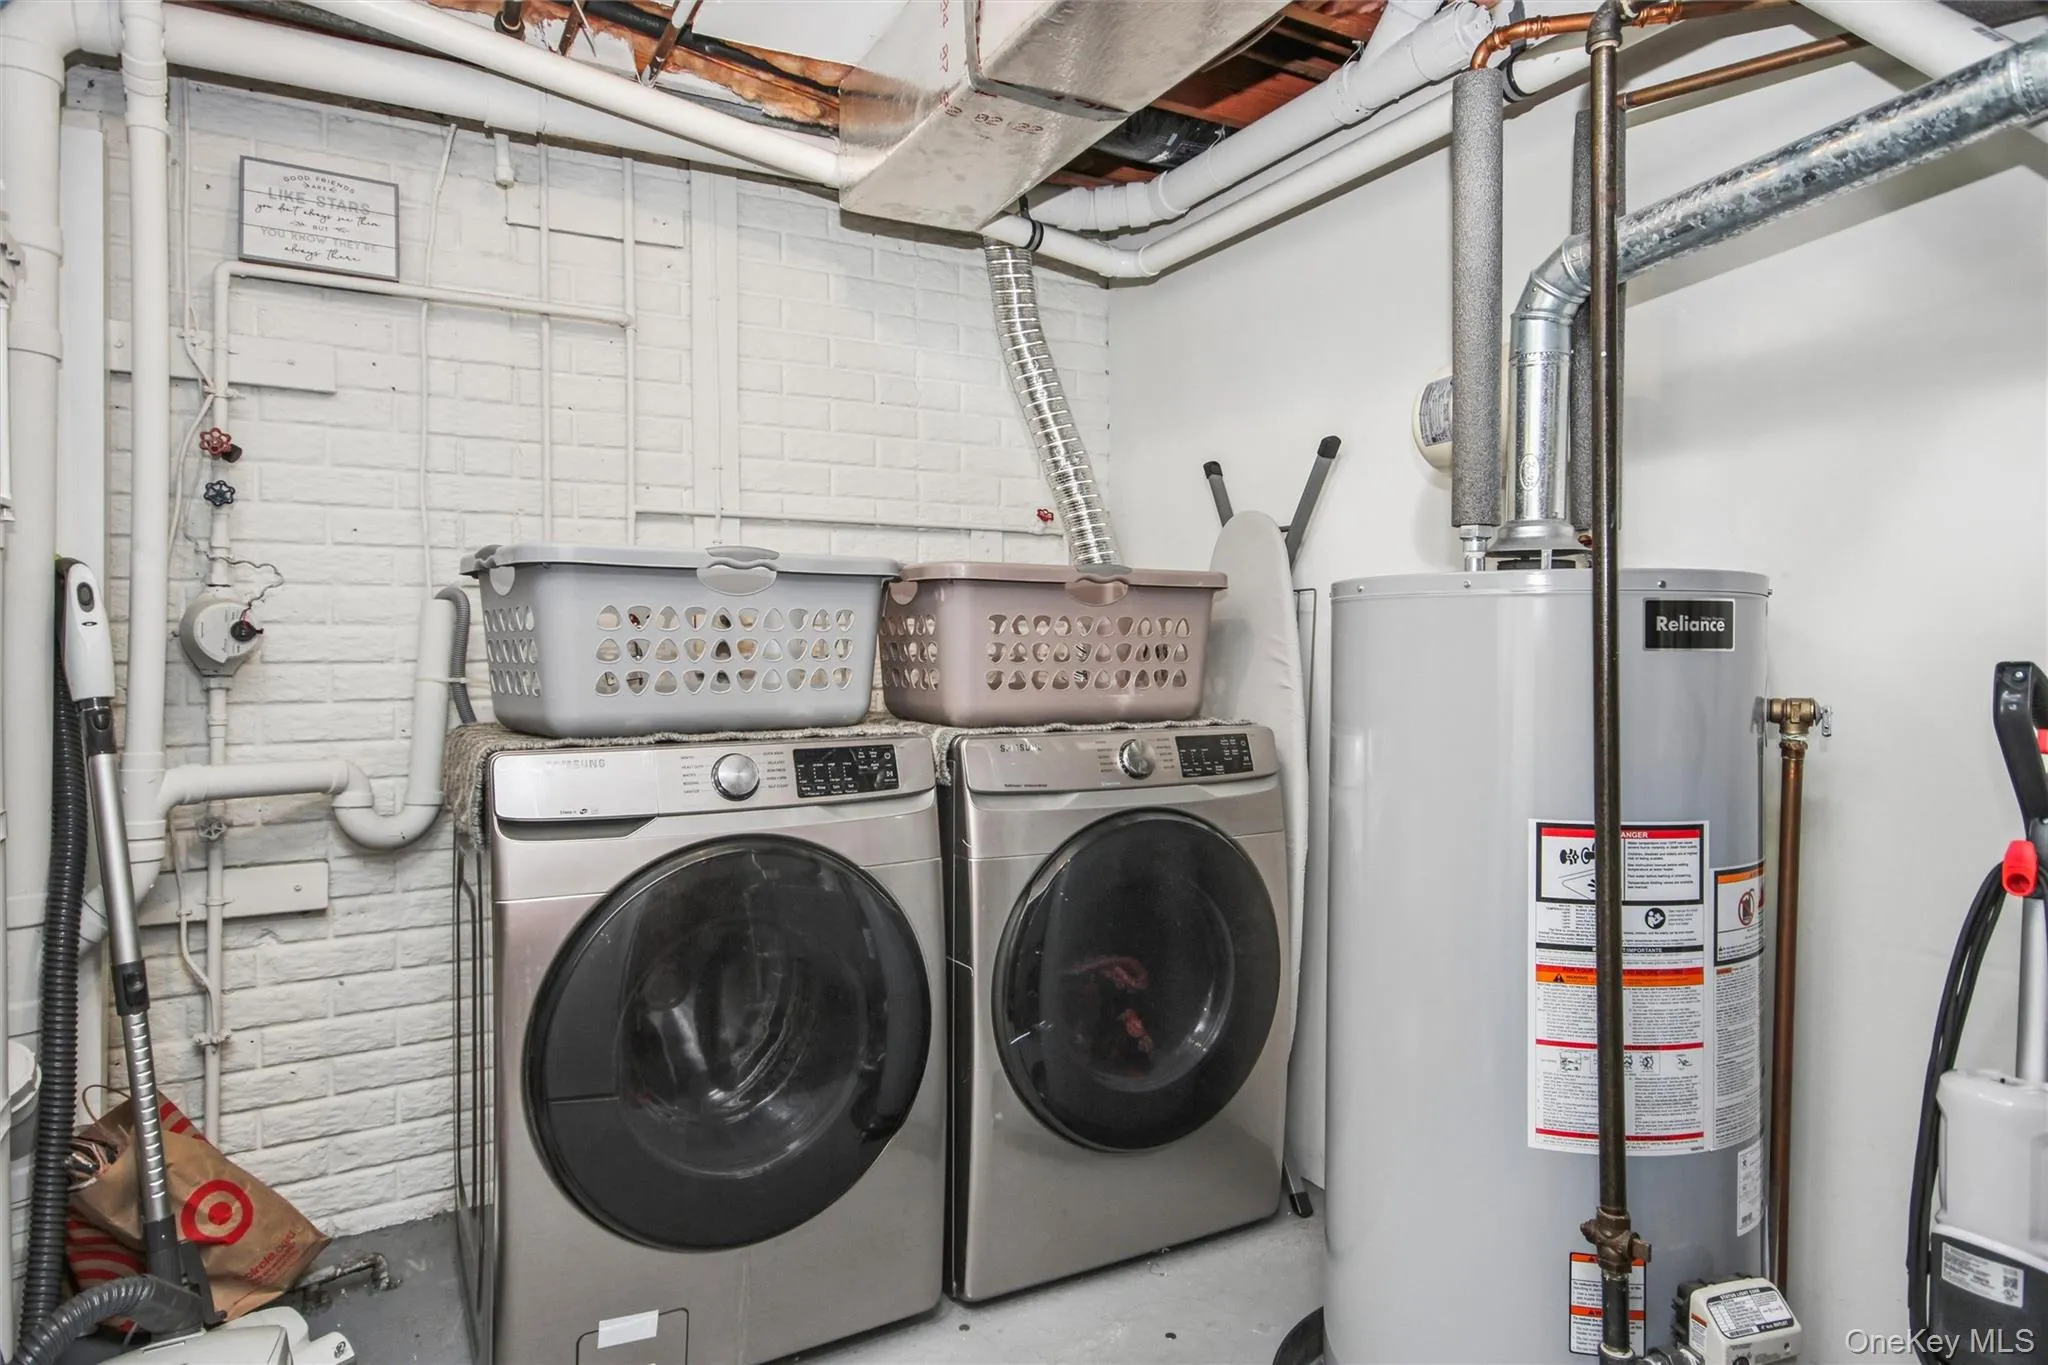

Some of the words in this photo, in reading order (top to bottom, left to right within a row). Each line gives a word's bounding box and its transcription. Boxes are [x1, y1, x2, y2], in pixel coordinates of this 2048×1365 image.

[282, 175, 311, 183] GOOD
[315, 175, 356, 194] FRIENDS
[268, 186, 306, 205] LIKE
[316, 195, 371, 216] STARS
[303, 208, 333, 224] always
[261, 226, 286, 239] YOU
[291, 232, 327, 246] KNOW
[283, 244, 321, 262] always
[1656, 614, 1726, 632] Reliance
[545, 758, 606, 770] MSUNG
